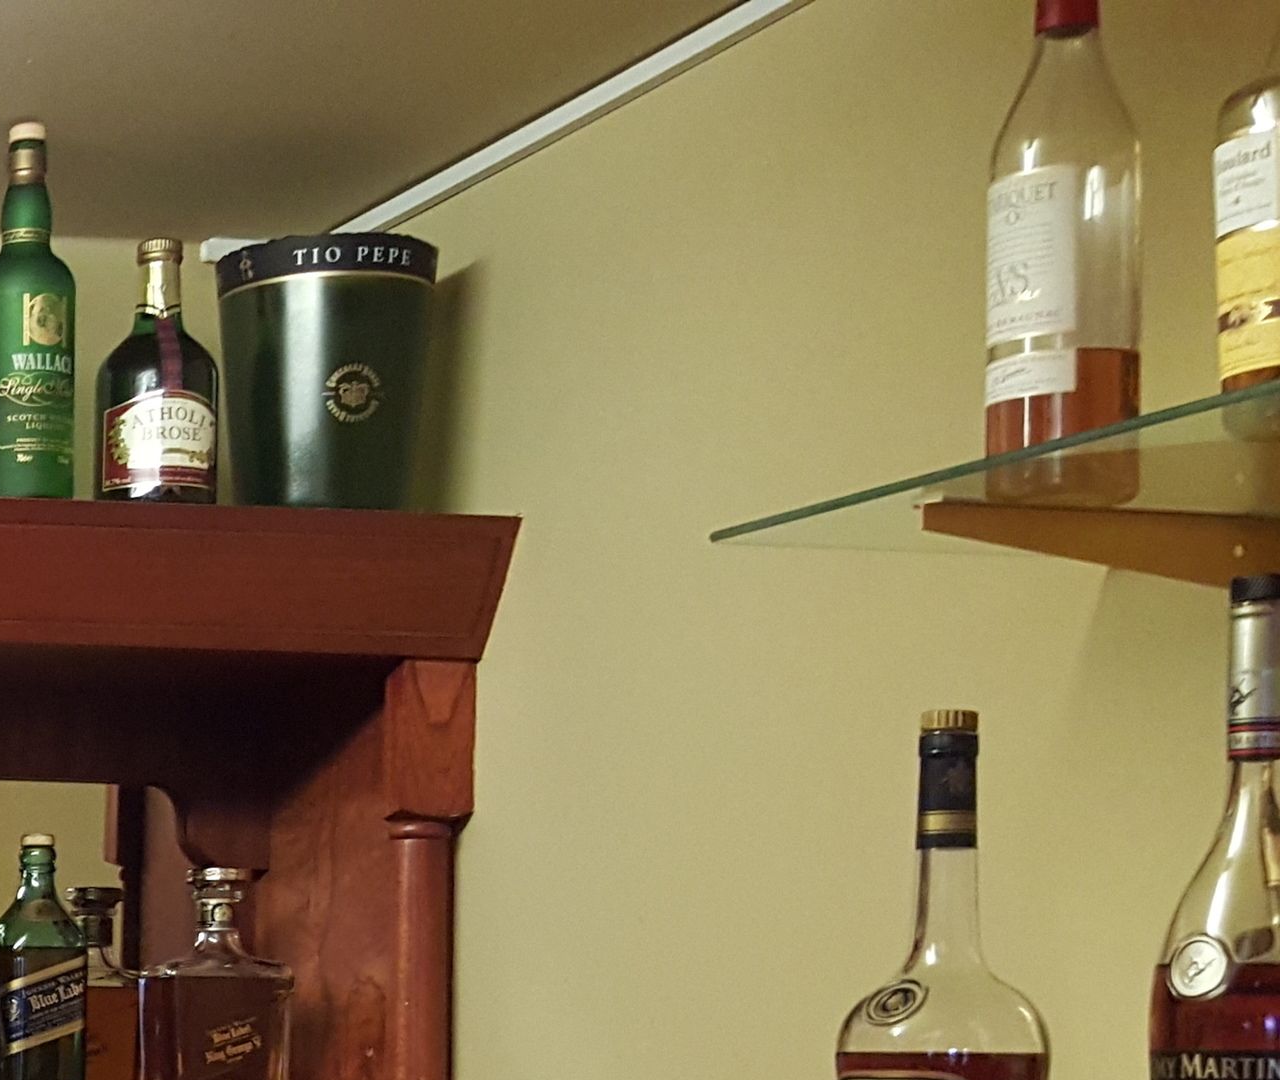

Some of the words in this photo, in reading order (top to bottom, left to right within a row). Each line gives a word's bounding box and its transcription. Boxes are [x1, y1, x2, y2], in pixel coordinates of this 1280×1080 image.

[293, 246, 341, 266] TIO
[355, 246, 412, 267] PEPE
[141, 425, 201, 443] BROSE
[30, 992, 59, 1014] Blue
